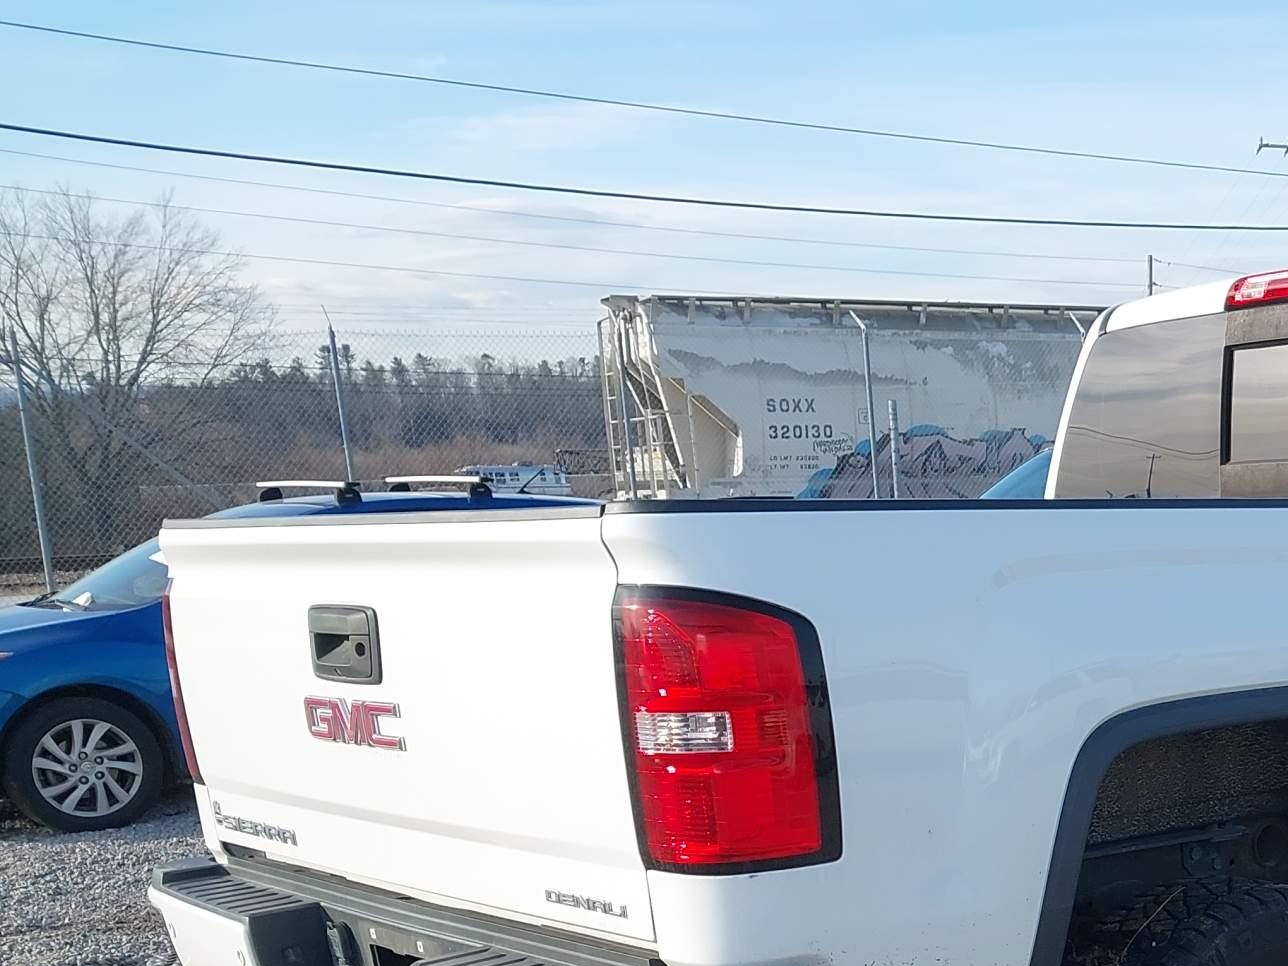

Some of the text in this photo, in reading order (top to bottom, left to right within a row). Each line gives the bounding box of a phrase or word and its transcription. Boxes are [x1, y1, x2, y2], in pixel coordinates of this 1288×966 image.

[766, 398, 816, 413] SOXX
[768, 424, 833, 439] 320130
[303, 694, 408, 752] GMC
[222, 814, 298, 847] SIERRA
[544, 888, 629, 920] DENALI
